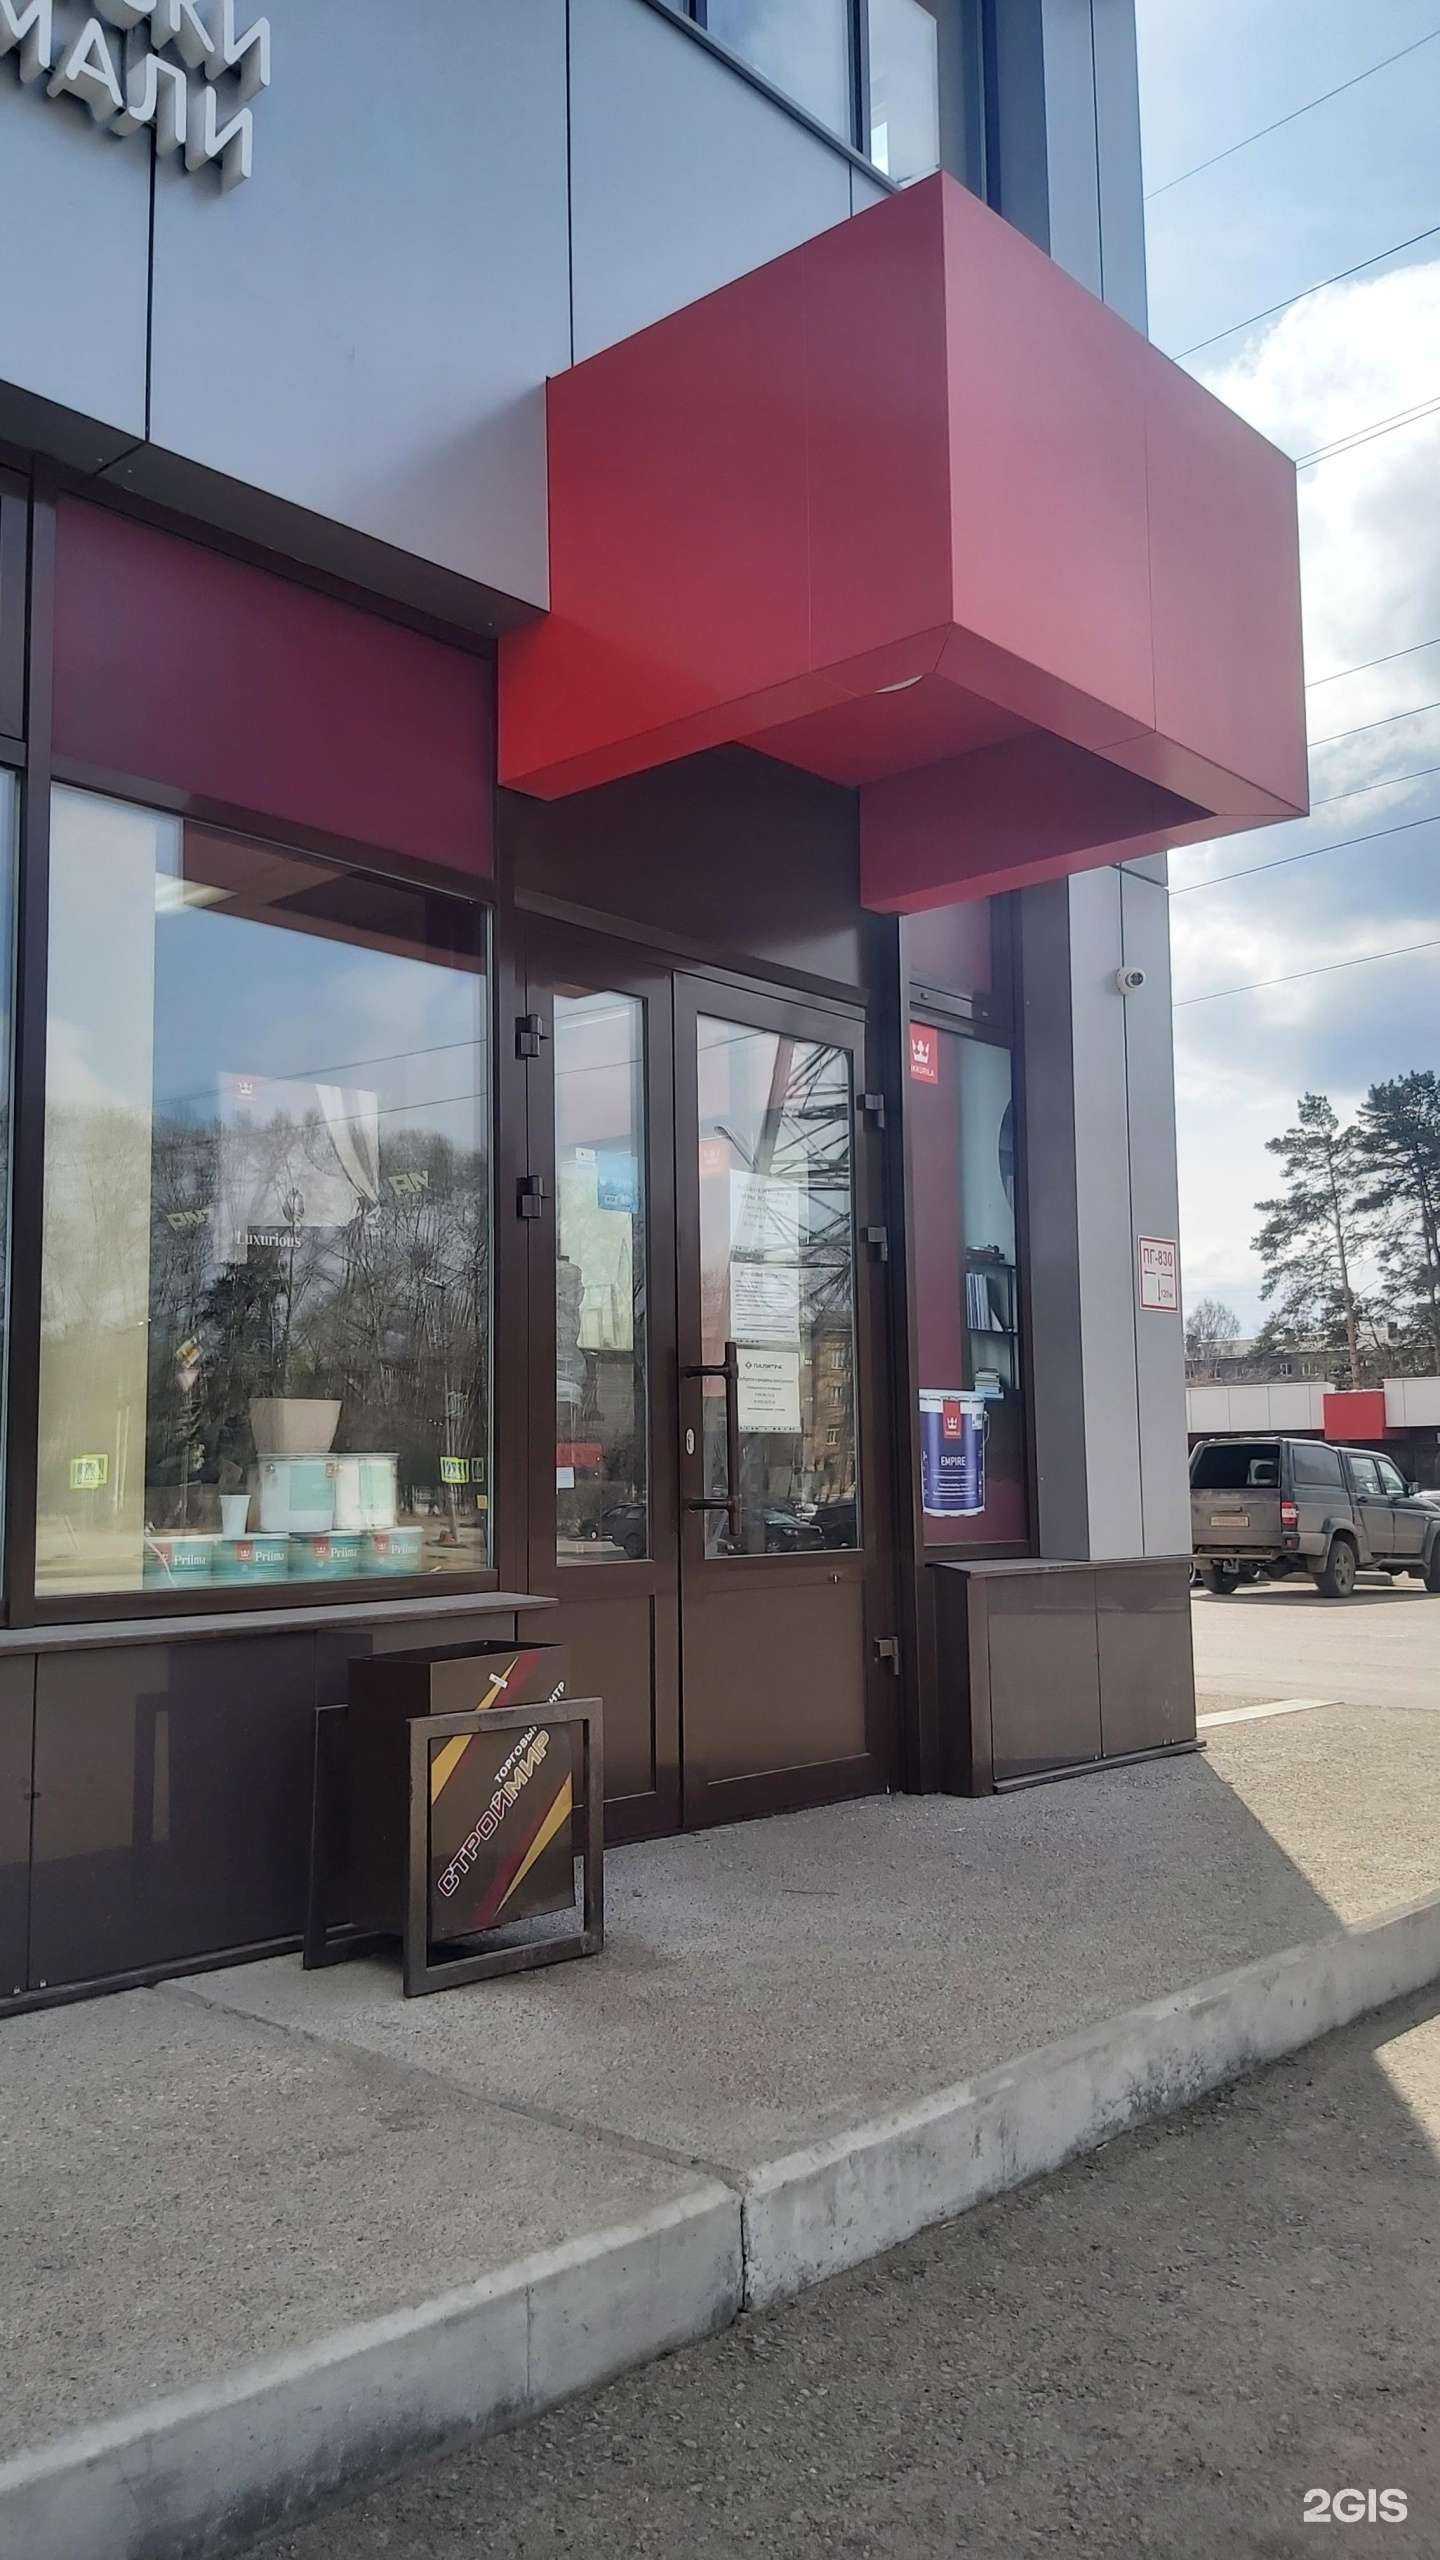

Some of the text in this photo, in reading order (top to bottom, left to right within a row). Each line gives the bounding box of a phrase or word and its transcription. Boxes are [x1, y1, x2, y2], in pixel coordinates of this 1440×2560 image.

[128, 0, 270, 86] КИ
[236, 1231, 302, 1249] Luxurious
[1143, 1248, 1173, 1266] ПГ-830
[940, 1456, 967, 1466] EMPIRE
[494, 1725, 538, 1783] ТОРГОВЫ
[437, 1729, 550, 1897] СТРОЙМИР
